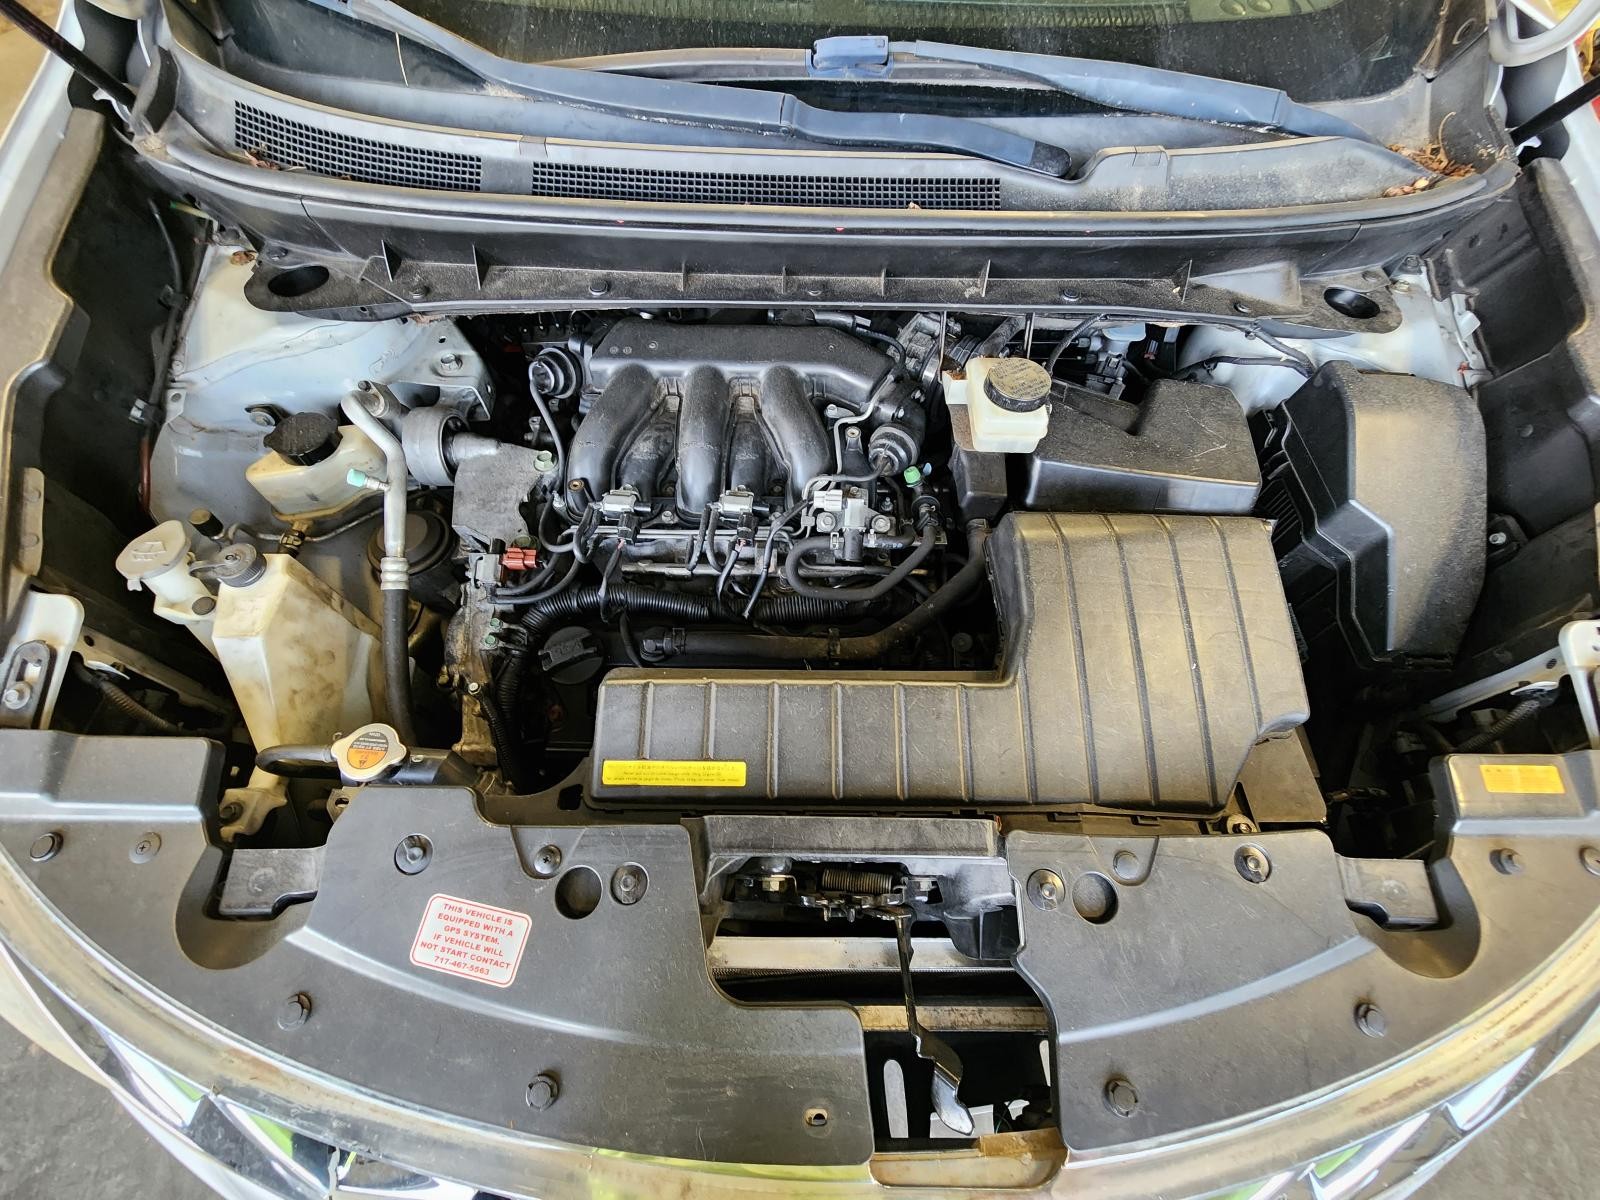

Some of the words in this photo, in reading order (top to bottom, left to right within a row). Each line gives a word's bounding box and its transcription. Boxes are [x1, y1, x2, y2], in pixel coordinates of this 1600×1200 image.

[437, 913, 480, 928] EQUIPPED
[483, 923, 506, 934] WITH
[443, 904, 463, 913] THIS
[465, 908, 502, 923] VEHICLE
[444, 925, 461, 934] GPS
[463, 930, 500, 944] SYSTEM.
[421, 941, 438, 951] NOT
[440, 946, 467, 959] START
[470, 954, 511, 969] CONTACT
[444, 936, 481, 951] VEHICLE
[483, 947, 503, 956] WILL
